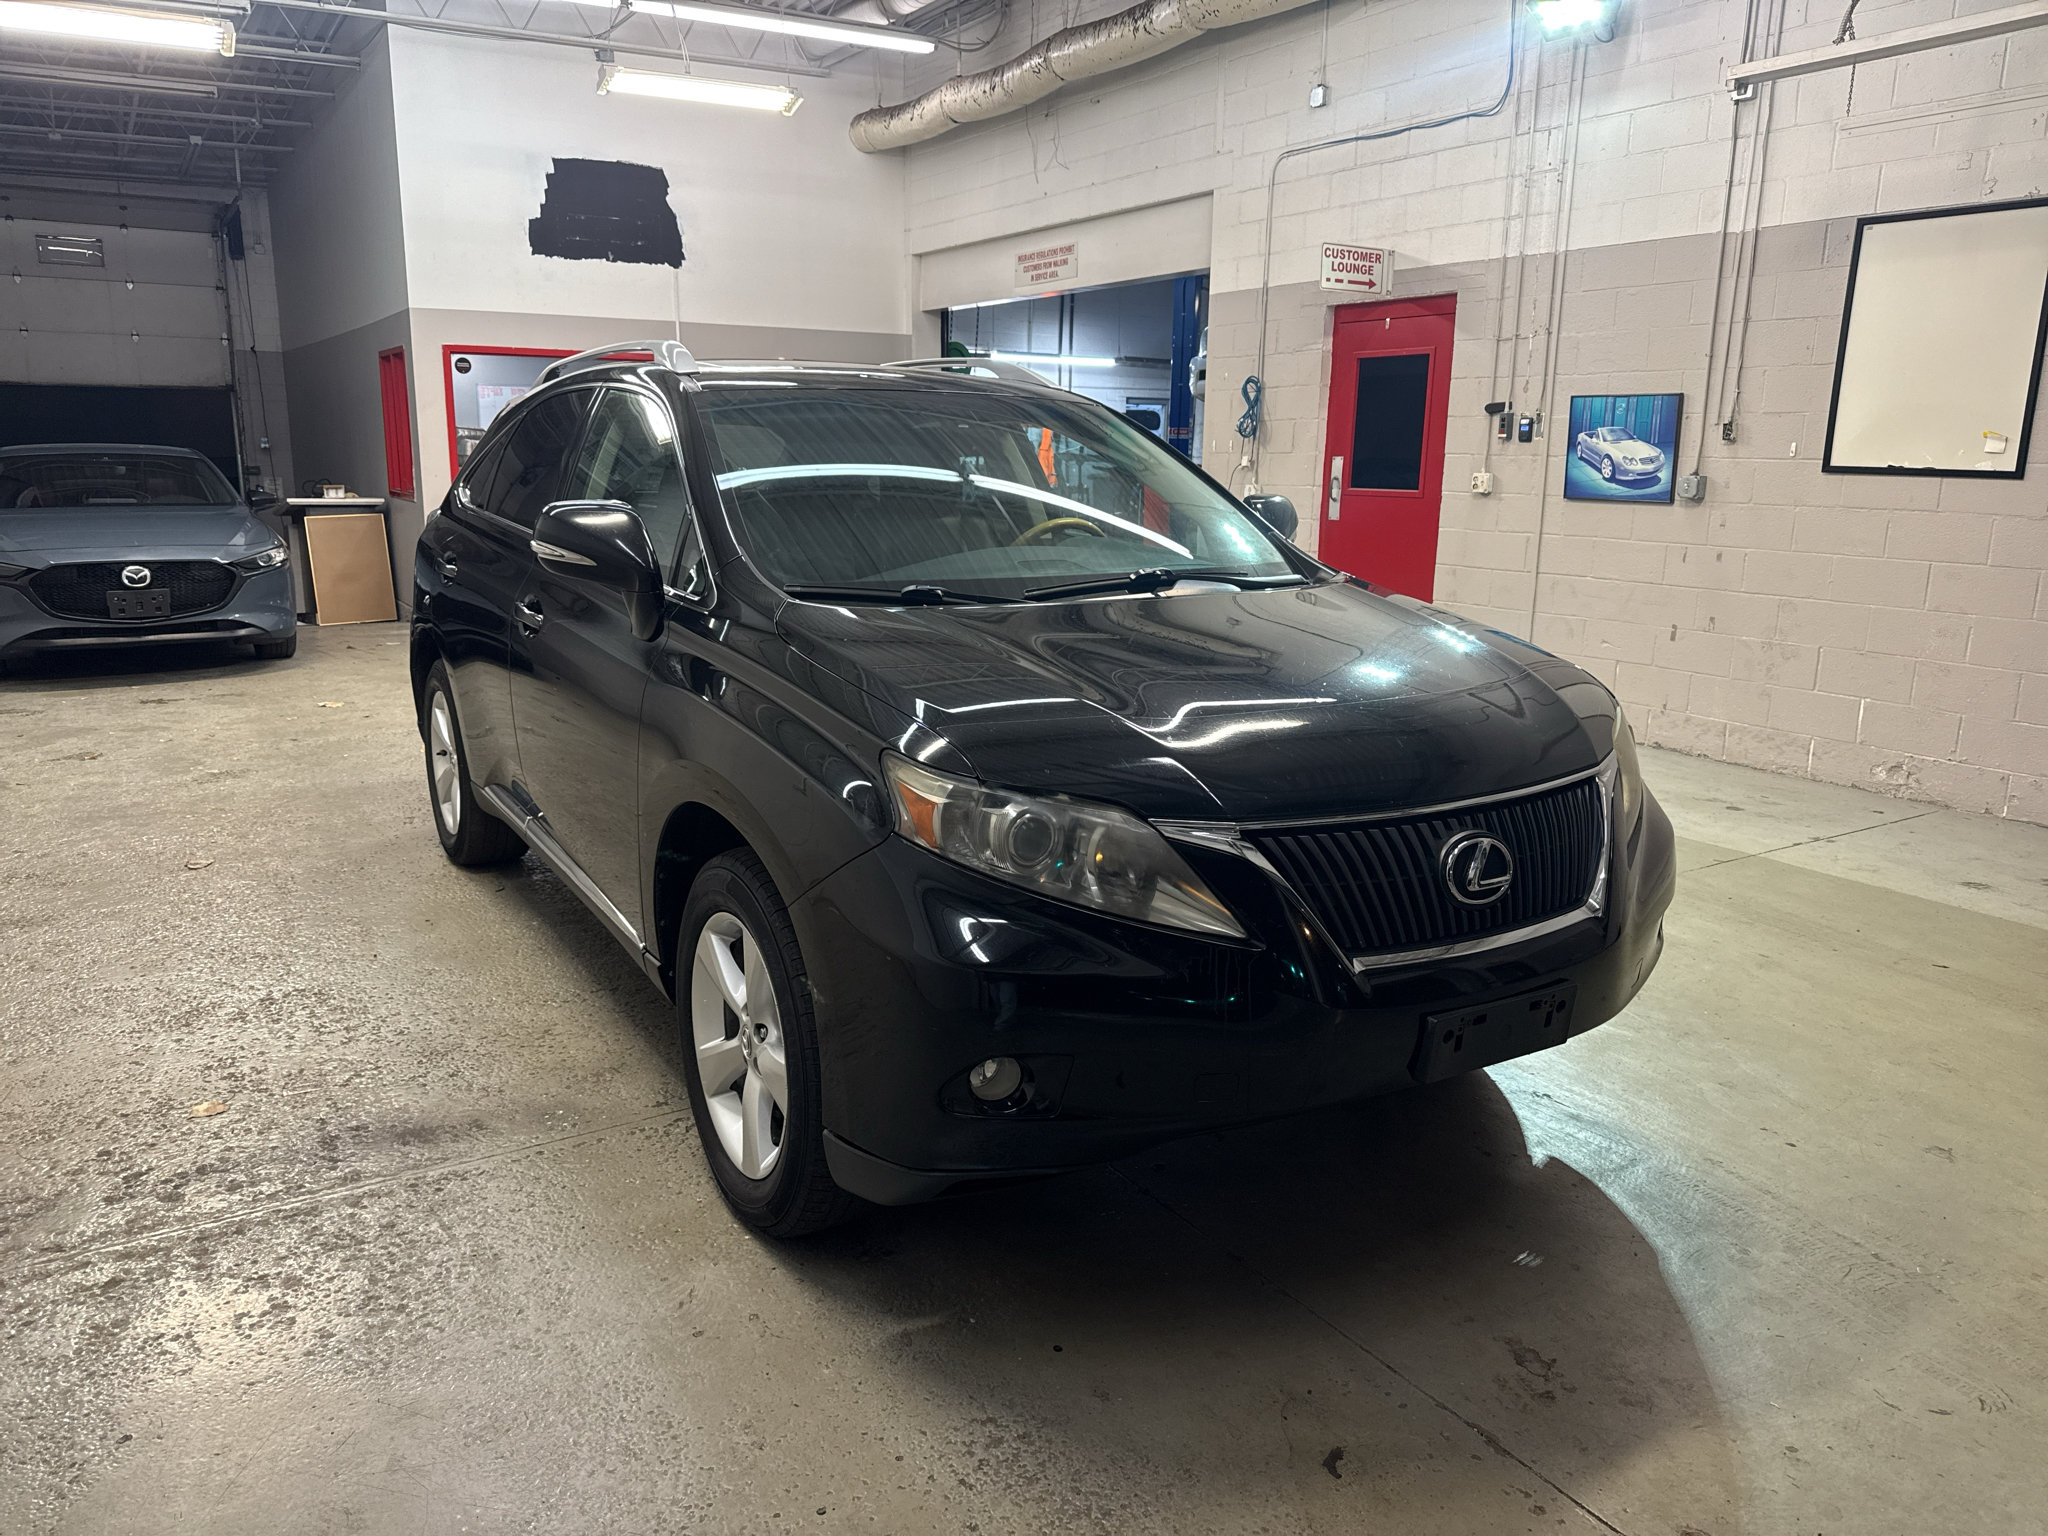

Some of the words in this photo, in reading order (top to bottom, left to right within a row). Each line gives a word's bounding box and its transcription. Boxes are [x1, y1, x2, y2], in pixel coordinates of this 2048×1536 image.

[1324, 247, 1382, 264] CUSTOMER
[1035, 271, 1048, 281] SERVICE
[1331, 261, 1374, 276] LOUNGE
